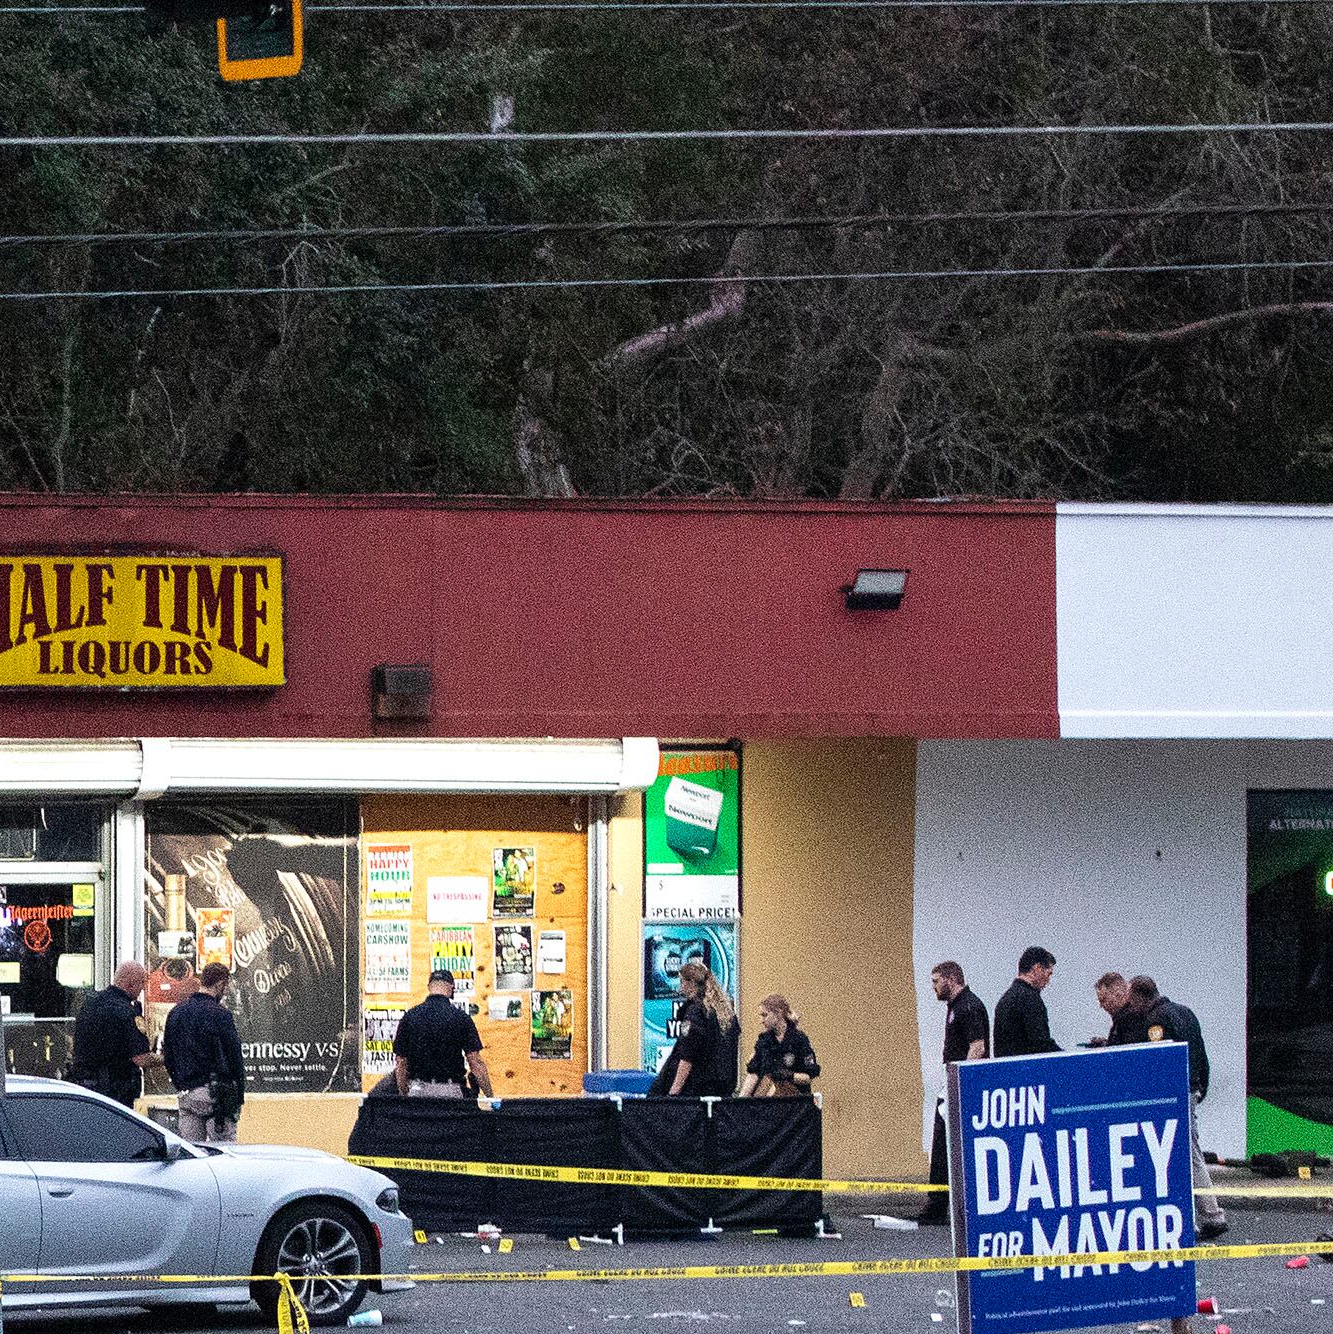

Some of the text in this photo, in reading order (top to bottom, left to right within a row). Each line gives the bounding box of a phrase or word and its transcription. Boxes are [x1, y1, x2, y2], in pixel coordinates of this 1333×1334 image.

[136, 564, 269, 668] TIME
[38, 640, 212, 679] LIQUORS
[241, 1042, 311, 1061] ennessy
[972, 1084, 1045, 1131] JOHN
[973, 1119, 1179, 1215] DAILEY
[977, 1205, 1184, 1281] FOR MAYOR
